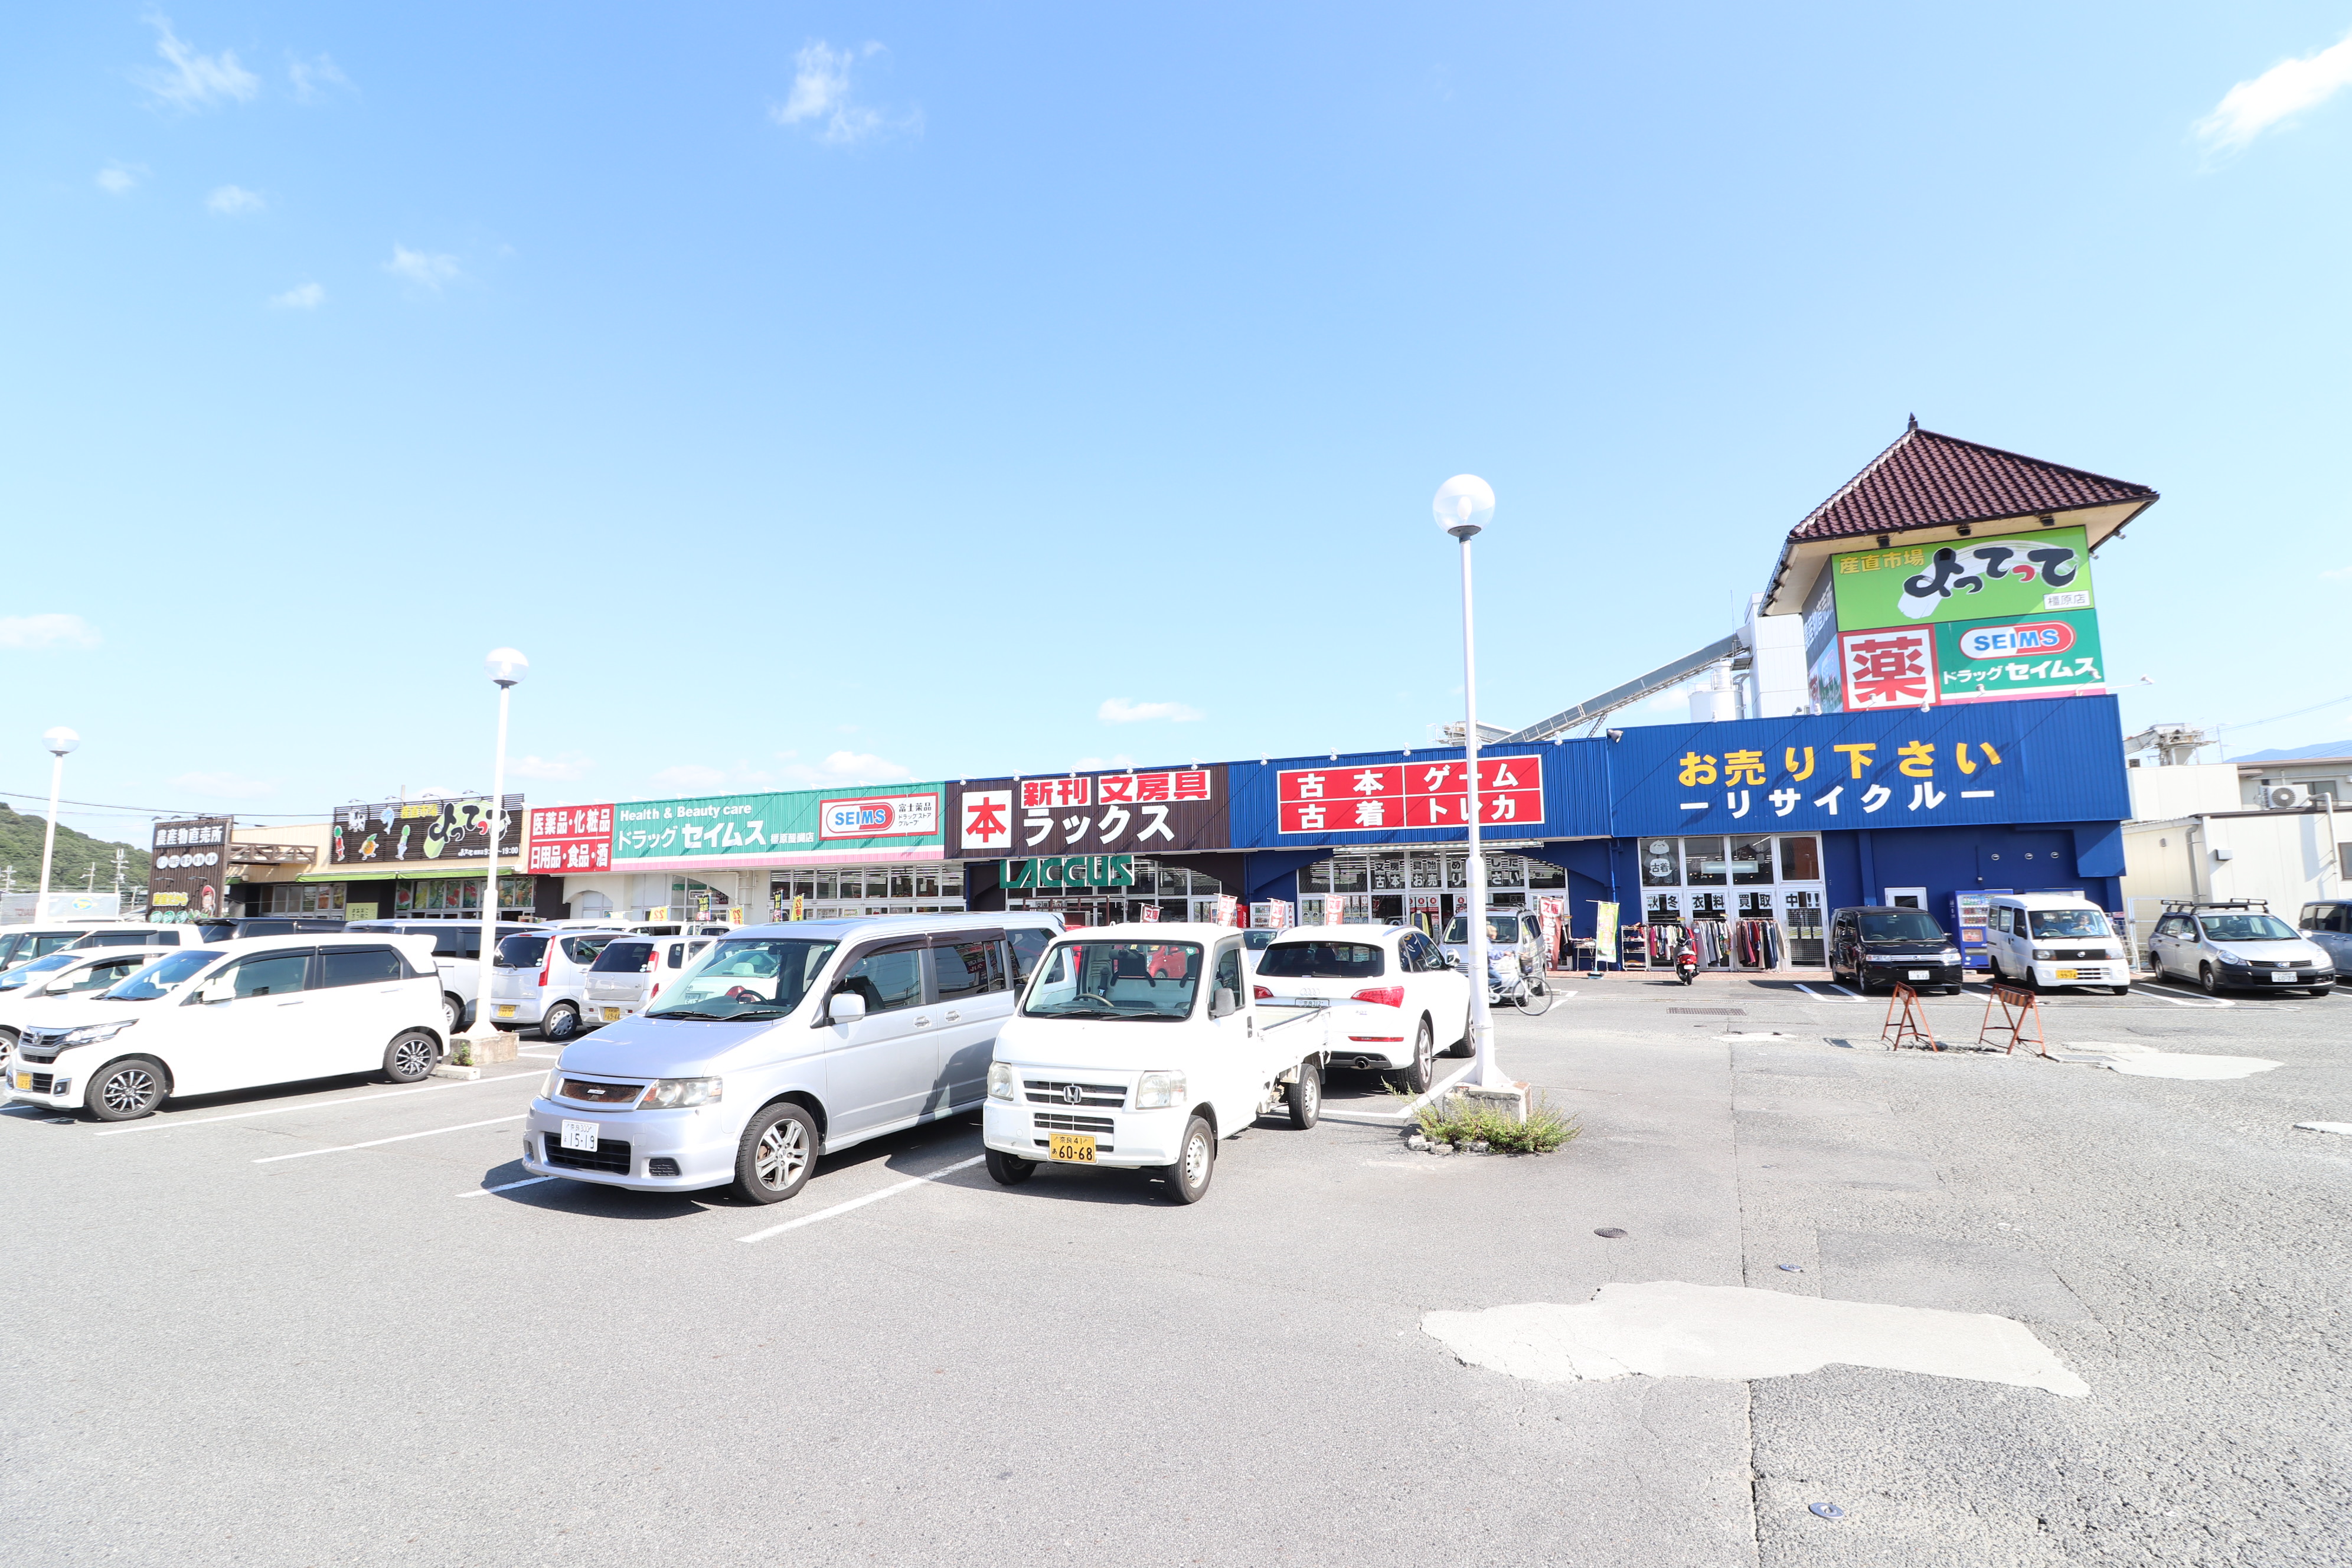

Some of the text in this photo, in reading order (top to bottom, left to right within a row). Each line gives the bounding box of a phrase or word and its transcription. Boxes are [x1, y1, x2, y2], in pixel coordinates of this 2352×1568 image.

[1839, 548, 1925, 574] 産直市場
[1903, 547, 2076, 598] よってって
[2047, 593, 2089, 606] 橿原店
[1974, 628, 2059, 652] SEIMS
[1850, 637, 1928, 703] 薬
[1679, 740, 2002, 788] お売り下さい
[1024, 771, 1207, 806] 新刊 文房具
[1298, 763, 1518, 798] 古本 ゲーム
[620, 804, 752, 822] Health & Beauty care
[835, 809, 886, 826] SEIMS
[899, 802, 931, 812] 富士薬品
[966, 797, 1006, 842] 本
[1298, 795, 1516, 829] 古着 トレカ
[533, 808, 610, 836] 医薬品・化粧品
[1024, 805, 1175, 847] ラックス
[155, 825, 223, 846] 農産物直売所
[530, 843, 609, 870] 日用品・食品・酒
[1375, 857, 1519, 872] 文房具始めした
[1651, 863, 1670, 873] 古着
[999, 855, 1135, 889] LACCUS
[1376, 871, 1520, 888] 古本お売りさい
[1145, 909, 1158, 919] 文庫
[1059, 1145, 1093, 1161] 60-68
[1060, 1136, 1082, 1145] 奈良41
